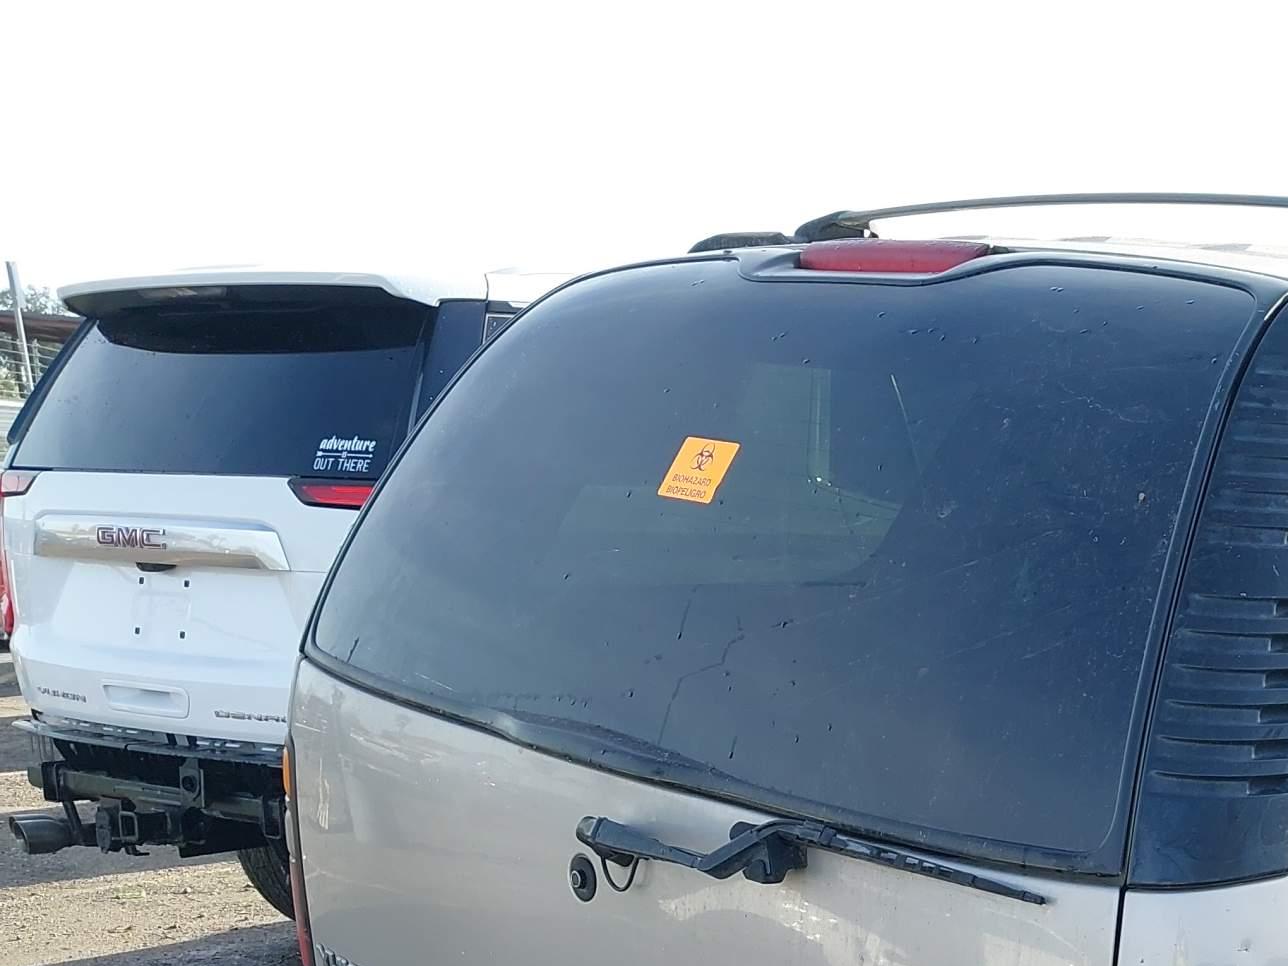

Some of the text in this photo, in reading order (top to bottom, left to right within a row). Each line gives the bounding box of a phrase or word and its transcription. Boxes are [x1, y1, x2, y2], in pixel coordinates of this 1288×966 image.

[319, 435, 376, 451] adventure
[313, 457, 371, 472] OUT THERE
[672, 474, 711, 486] BIOHAZARD
[96, 526, 167, 550] GMC
